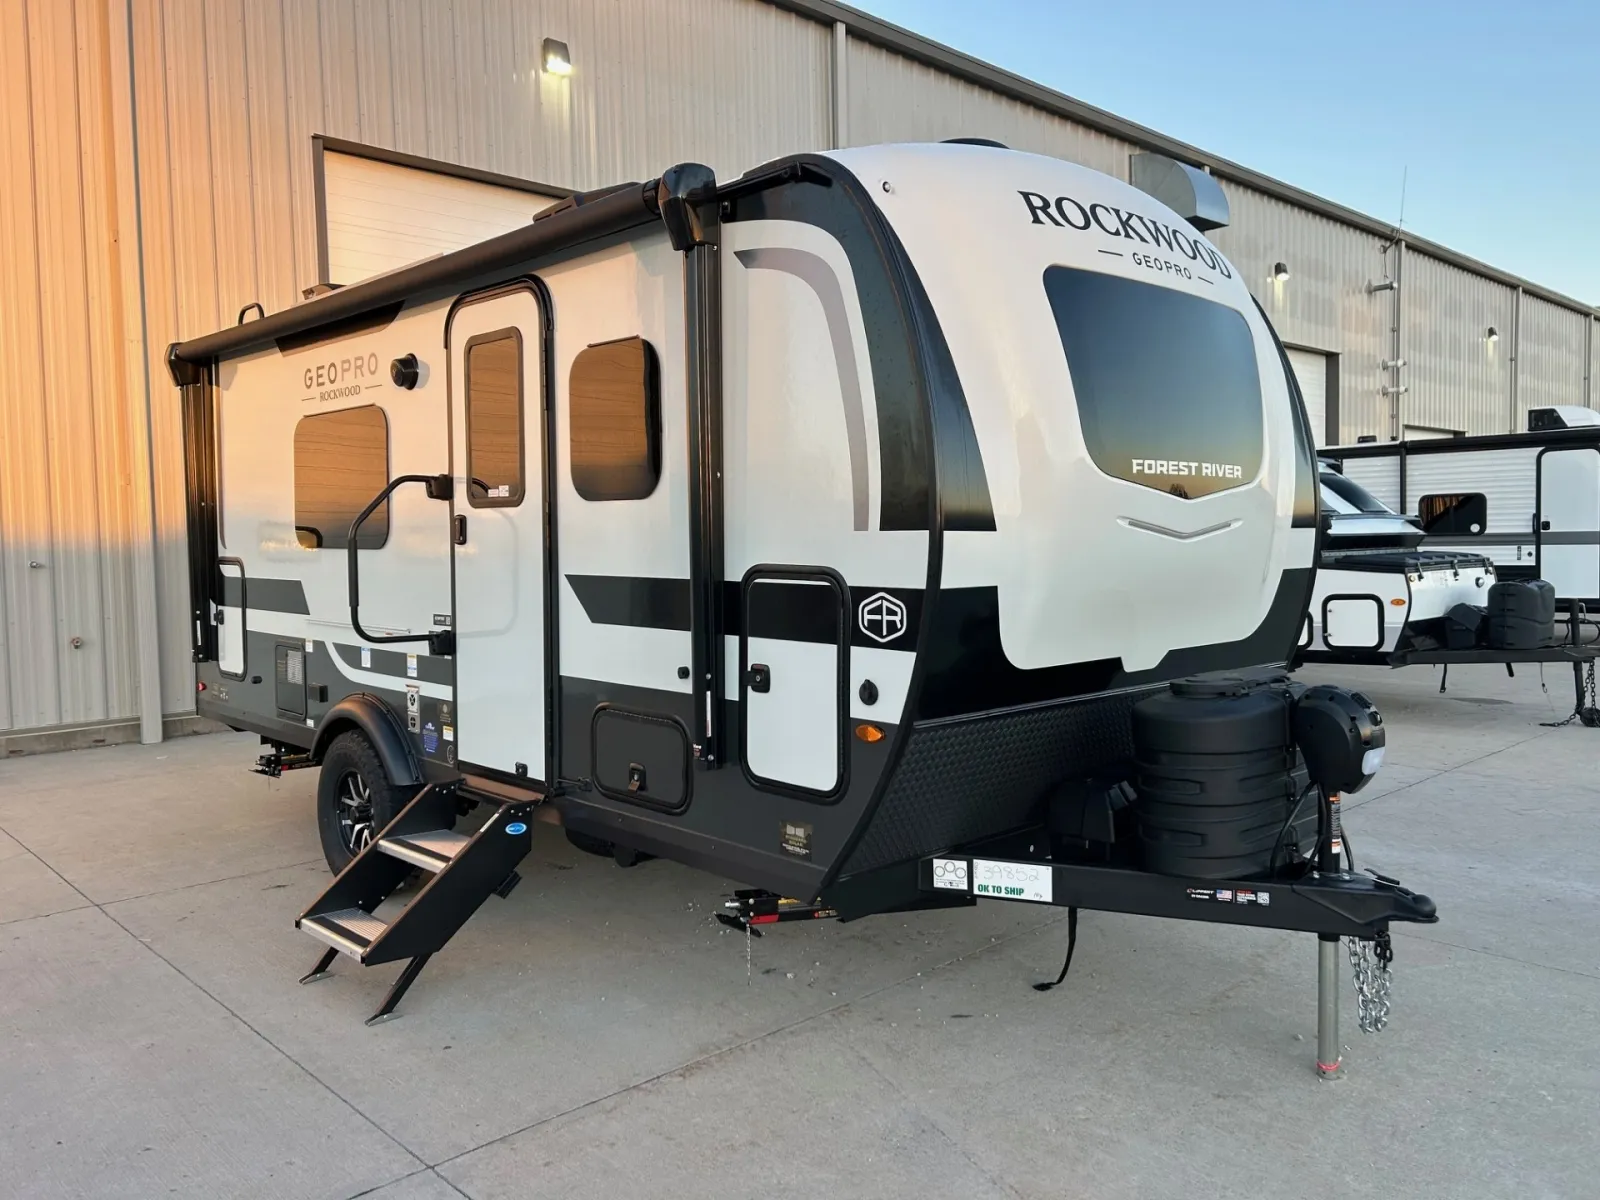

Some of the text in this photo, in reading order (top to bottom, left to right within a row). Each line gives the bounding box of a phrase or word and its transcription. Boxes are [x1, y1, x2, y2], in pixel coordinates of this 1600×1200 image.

[1016, 190, 1232, 280] ROCKWOOD
[1132, 252, 1192, 280] GEOPRO
[303, 352, 379, 390] GEOPRO
[319, 384, 361, 402] ROCKWOOD
[1131, 459, 1243, 479] FOREST RIVER
[983, 864, 1041, 882] 39852
[977, 883, 990, 894] OK
[992, 885, 1003, 894] TO
[1004, 886, 1025, 897] SHIP
